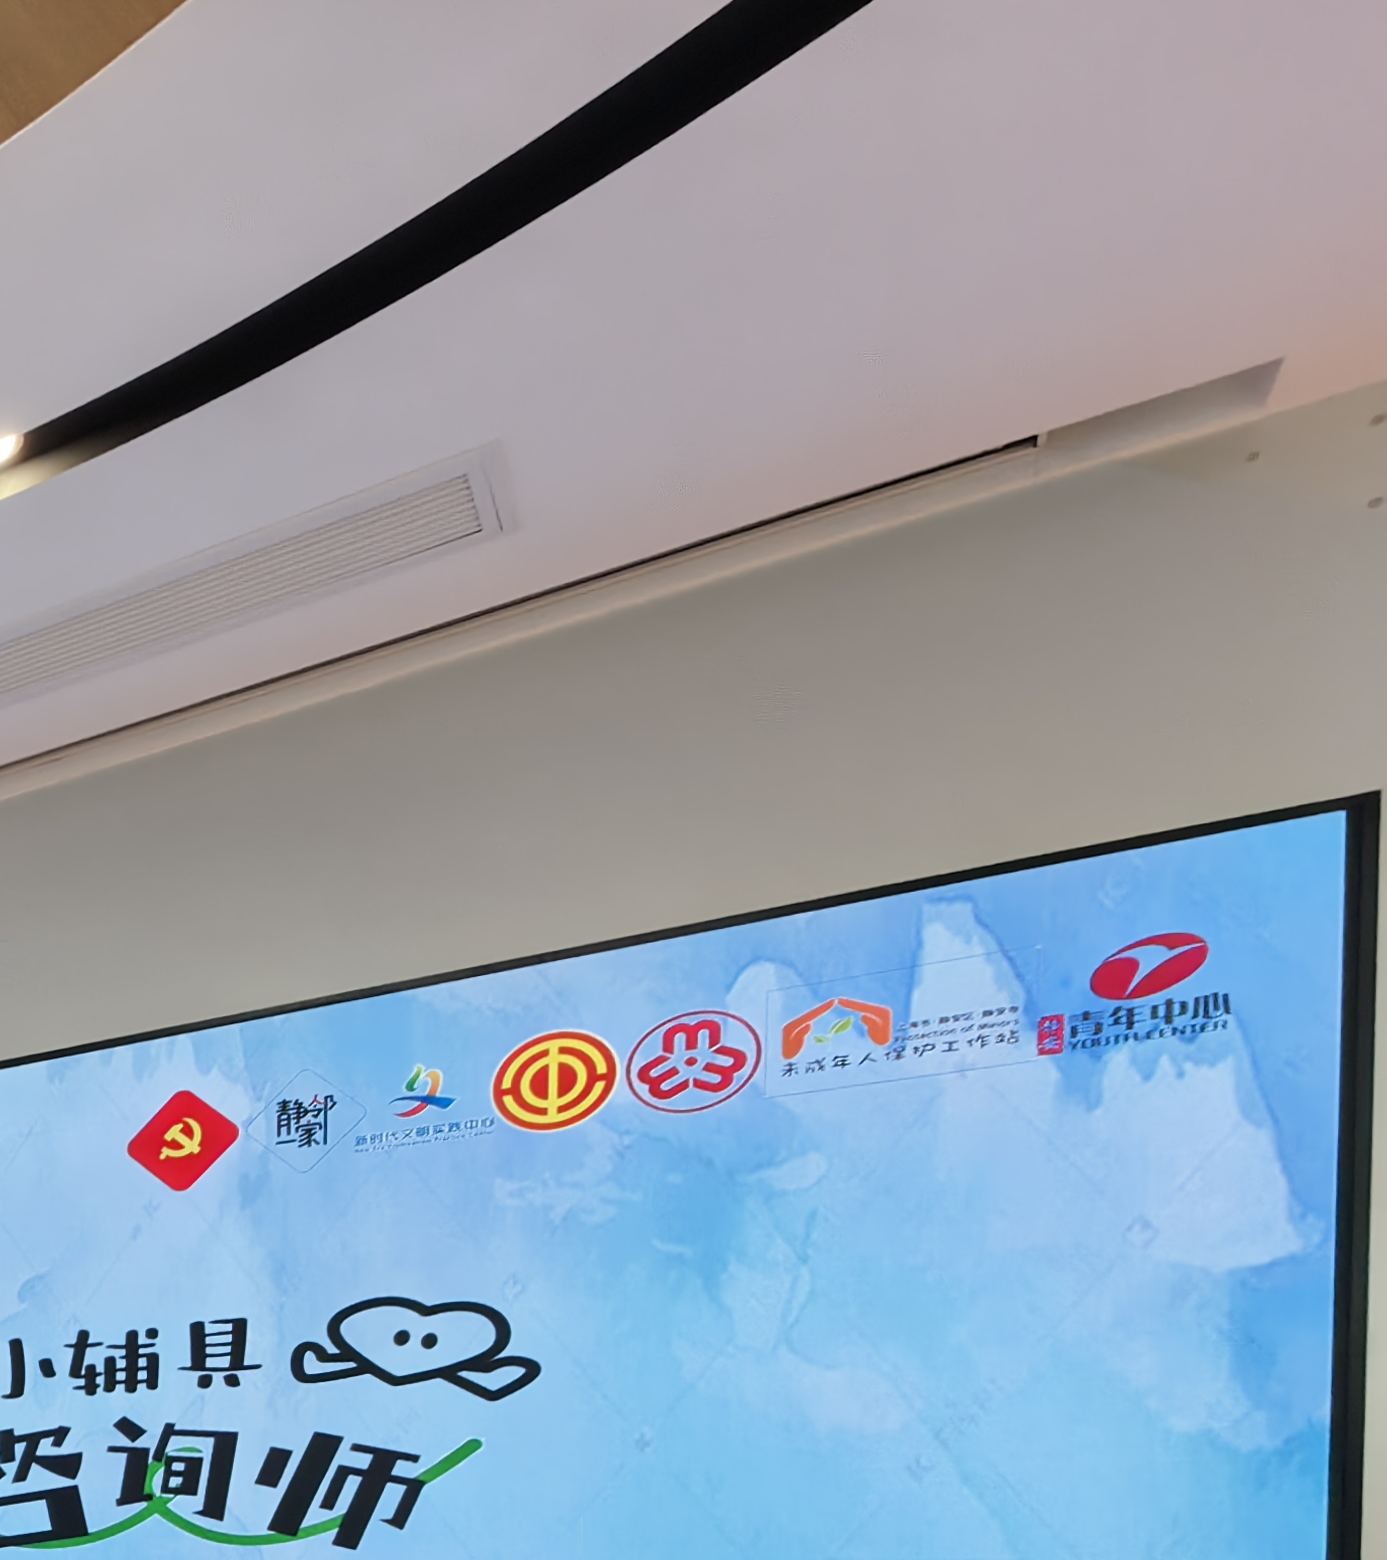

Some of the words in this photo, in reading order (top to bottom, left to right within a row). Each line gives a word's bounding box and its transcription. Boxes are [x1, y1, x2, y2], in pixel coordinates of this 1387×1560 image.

[1068, 991, 1232, 1038] 青年中心
[780, 1030, 1020, 1078] 未成年人保护工作站
[1069, 1031, 1141, 1053] YOUTH
[1146, 1019, 1228, 1041] CENTER
[354, 1116, 496, 1147] 新时代文明实践中心
